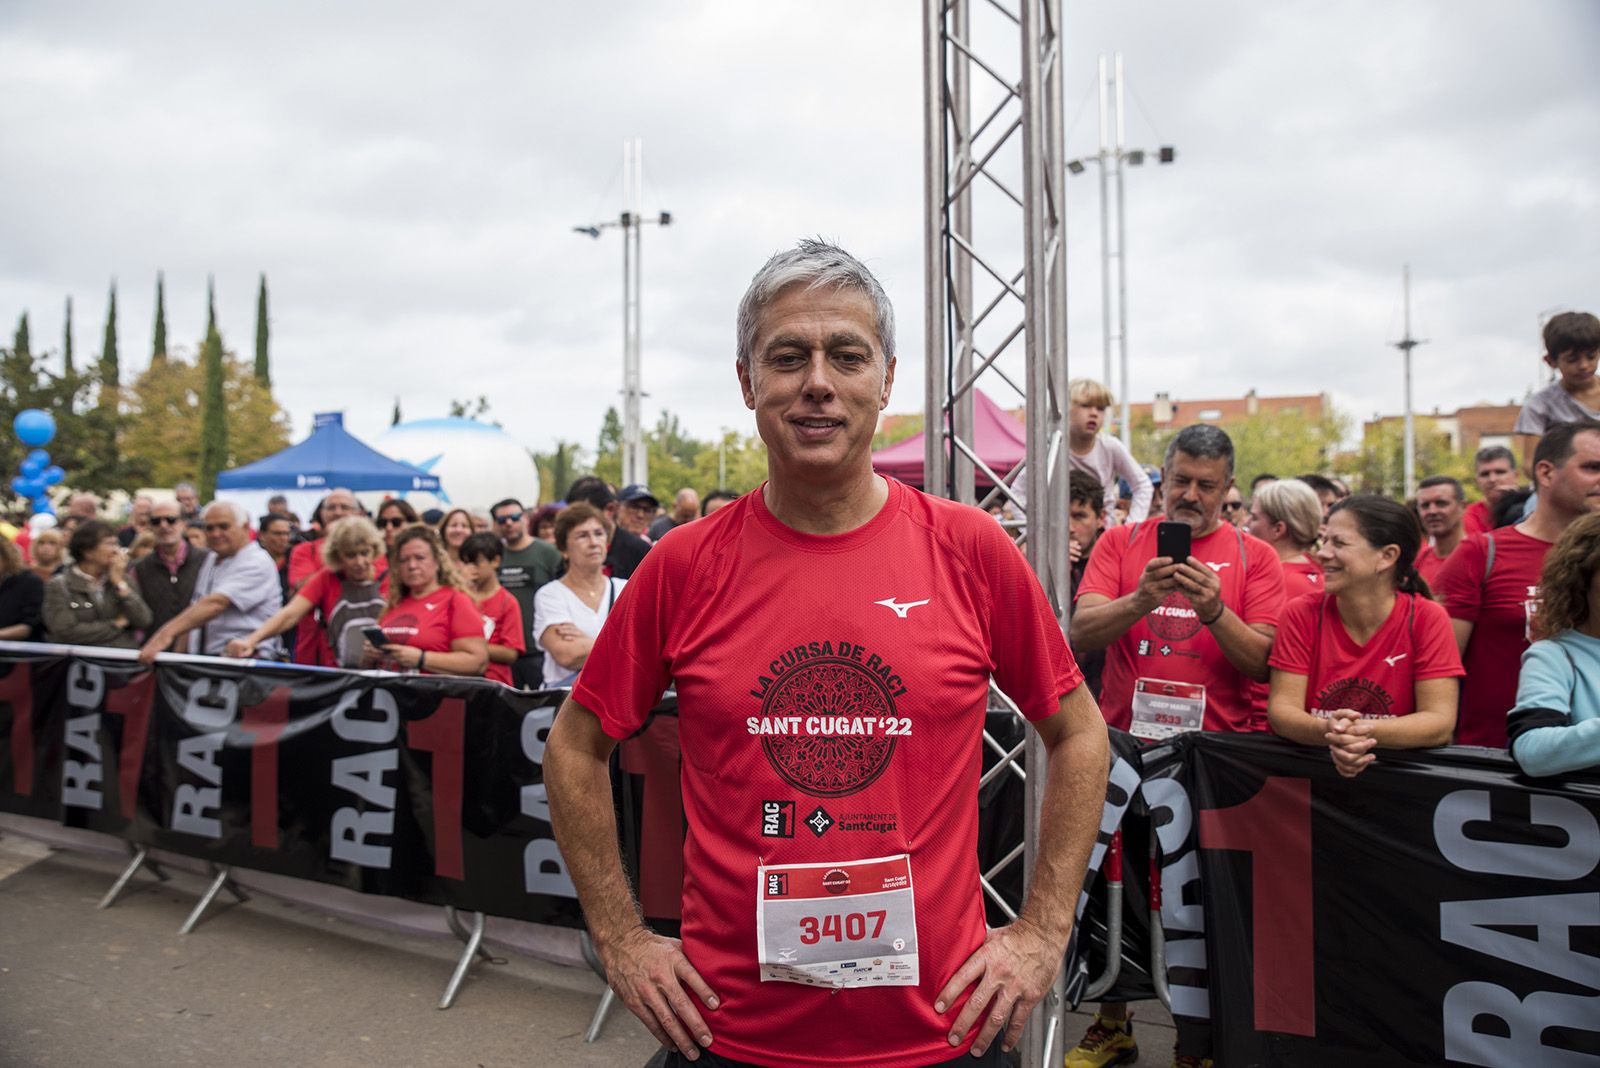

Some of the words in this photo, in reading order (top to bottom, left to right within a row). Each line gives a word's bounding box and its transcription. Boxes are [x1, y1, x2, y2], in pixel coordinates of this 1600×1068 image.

[750, 674, 774, 699] LA
[769, 641, 834, 676] CURSA
[838, 641, 866, 662] DE
[62, 664, 105, 809] RAC
[107, 671, 155, 819] 1
[746, 716, 802, 735] SANT
[805, 716, 876, 735] CUGAT
[171, 677, 239, 839] RAC
[241, 687, 292, 849] 1
[330, 687, 399, 869] RAC
[406, 697, 466, 881] 1
[764, 802, 780, 835] RAC
[780, 803, 793, 836] 1
[838, 821, 897, 833] SantCugat
[769, 874, 778, 895] RAC
[1200, 776, 1315, 1037] 1
[800, 910, 887, 945] 3407
[1433, 789, 1600, 1068] RAC
